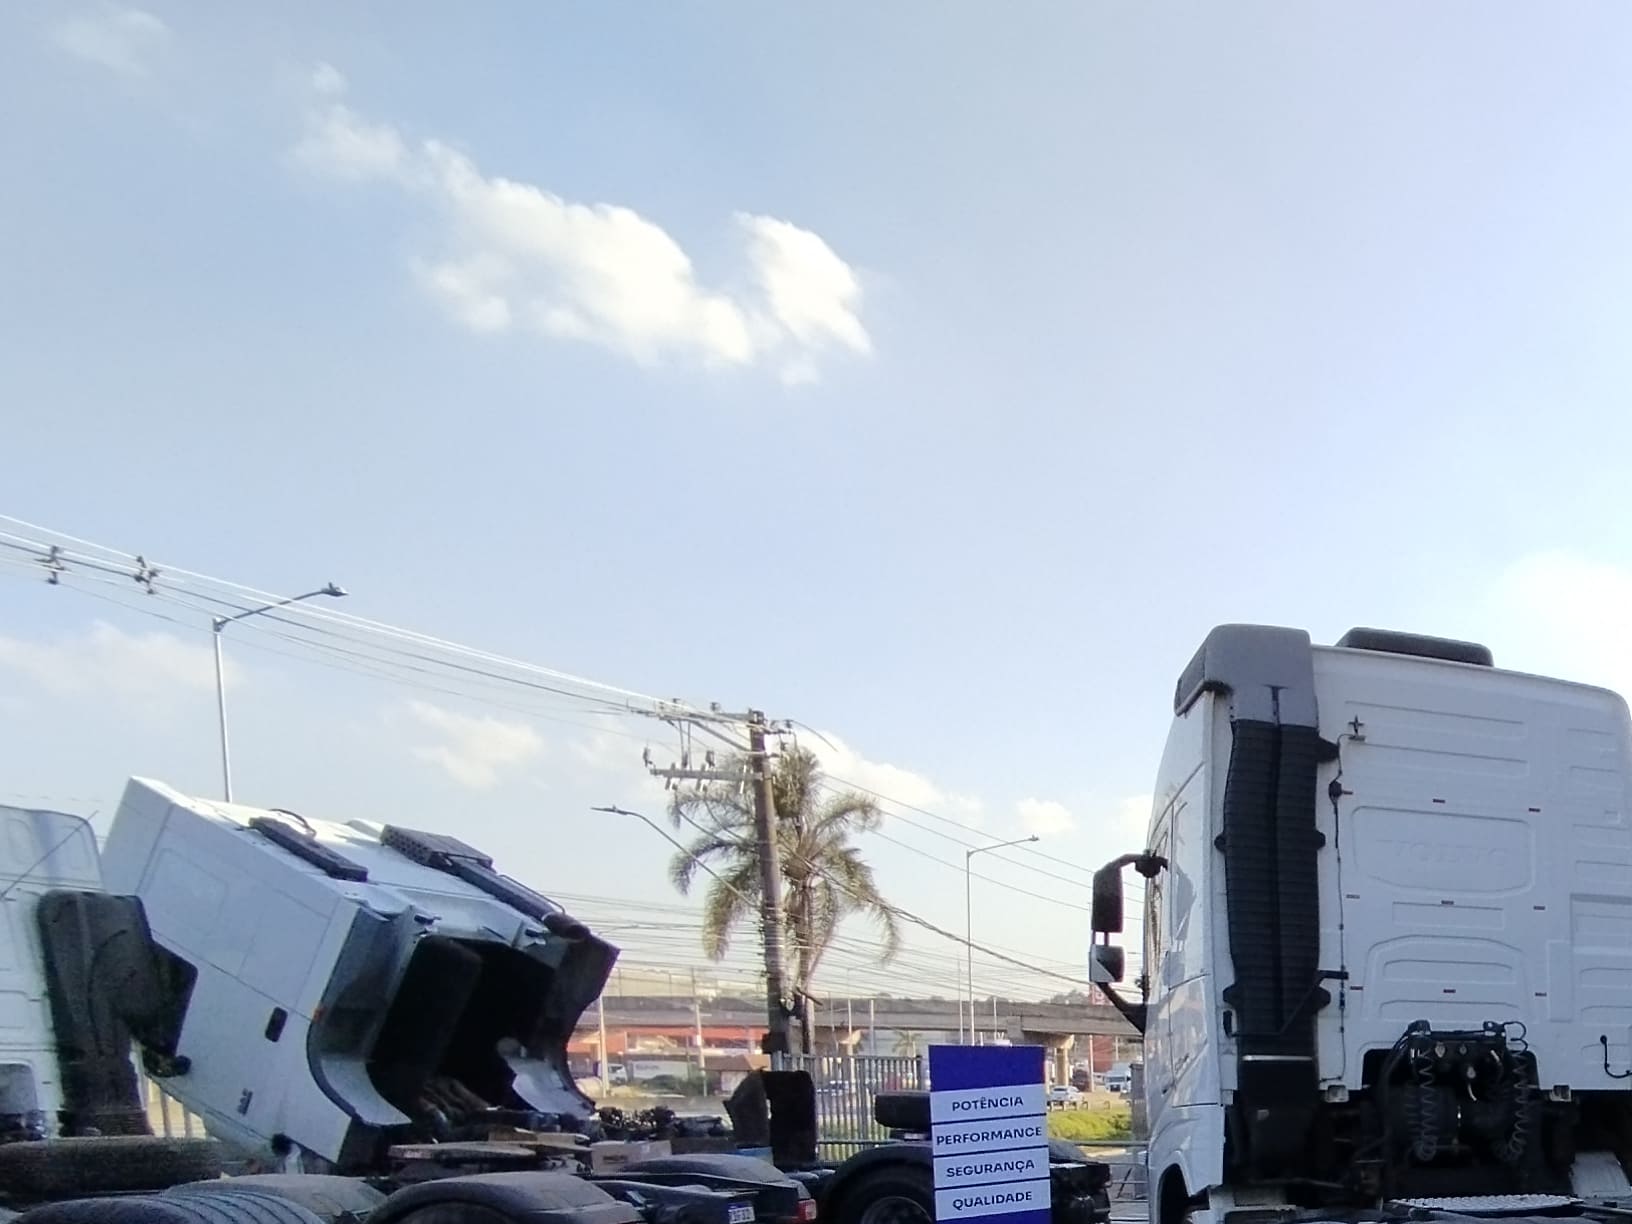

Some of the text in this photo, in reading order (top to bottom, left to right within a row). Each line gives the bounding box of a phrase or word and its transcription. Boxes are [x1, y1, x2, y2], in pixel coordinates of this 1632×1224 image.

[952, 1096, 1024, 1112] POTÊNCIA
[936, 1126, 1042, 1146] PERFORMANCE
[946, 1159, 1035, 1178] SEGURANÇA
[952, 1191, 1033, 1211] QUALIDADE
